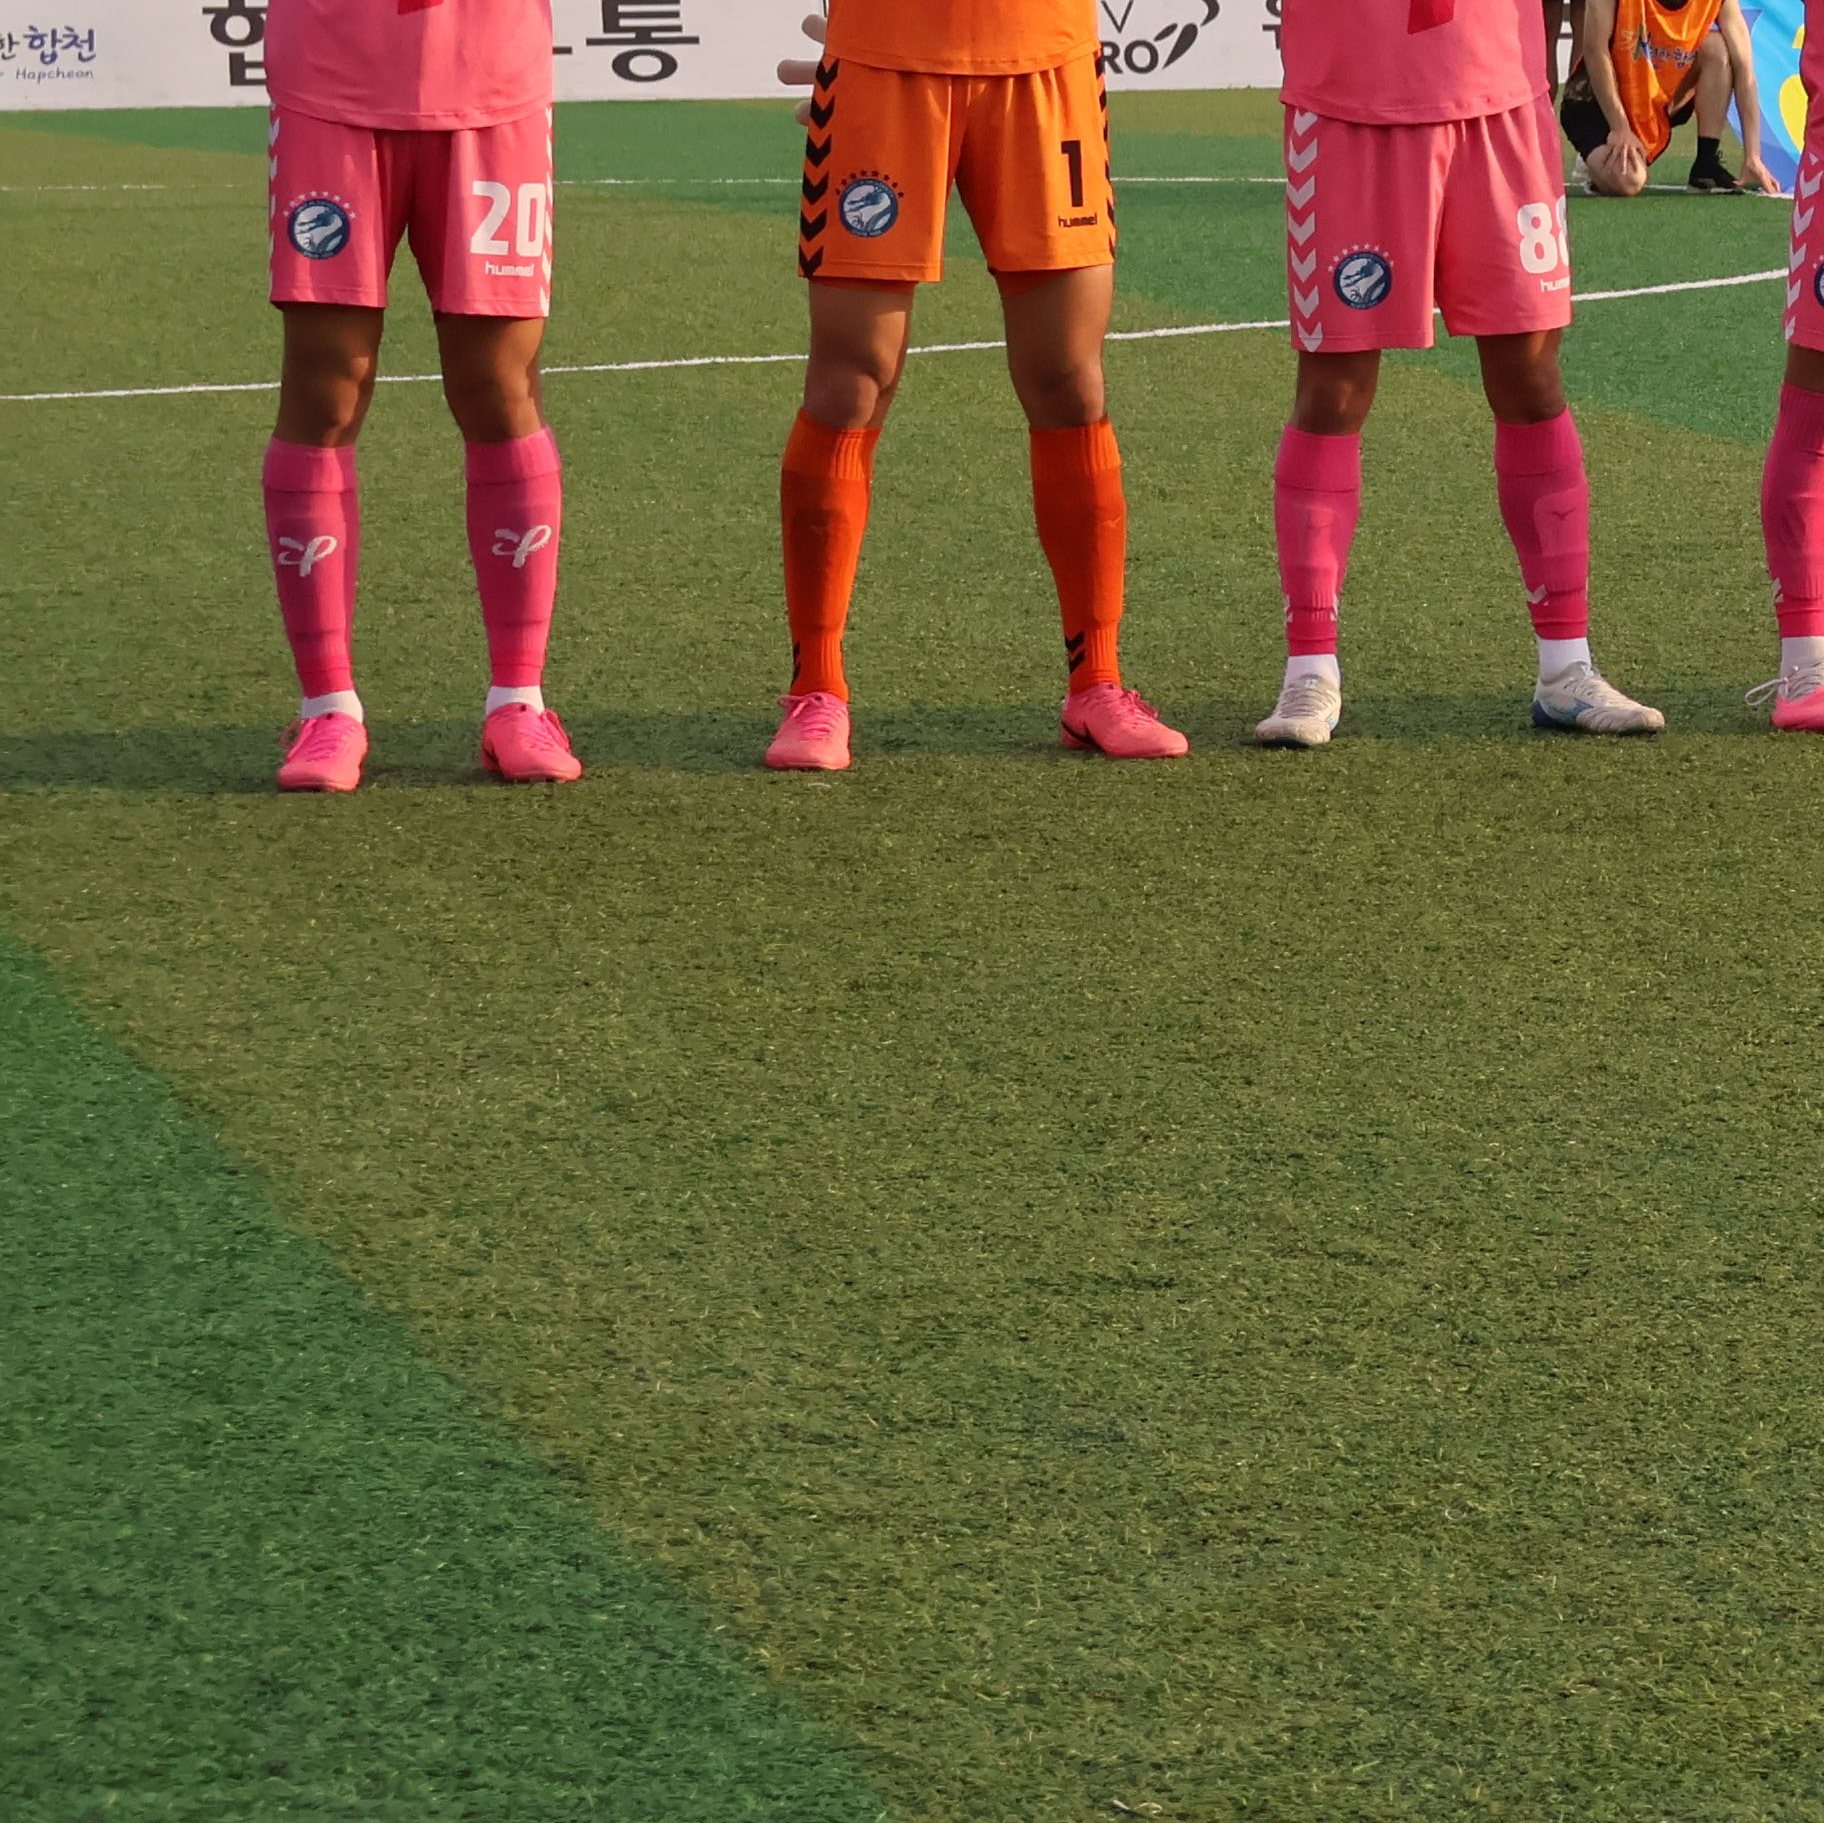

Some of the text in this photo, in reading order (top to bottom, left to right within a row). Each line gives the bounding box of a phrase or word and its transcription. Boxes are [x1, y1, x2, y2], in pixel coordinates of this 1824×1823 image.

[23, 26, 96, 65] 합천
[15, 69, 93, 84] Hapcheon
[1061, 140, 1083, 207] 1
[470, 180, 546, 257] 20
[1058, 213, 1097, 227] hummel
[485, 261, 534, 277] hummel
